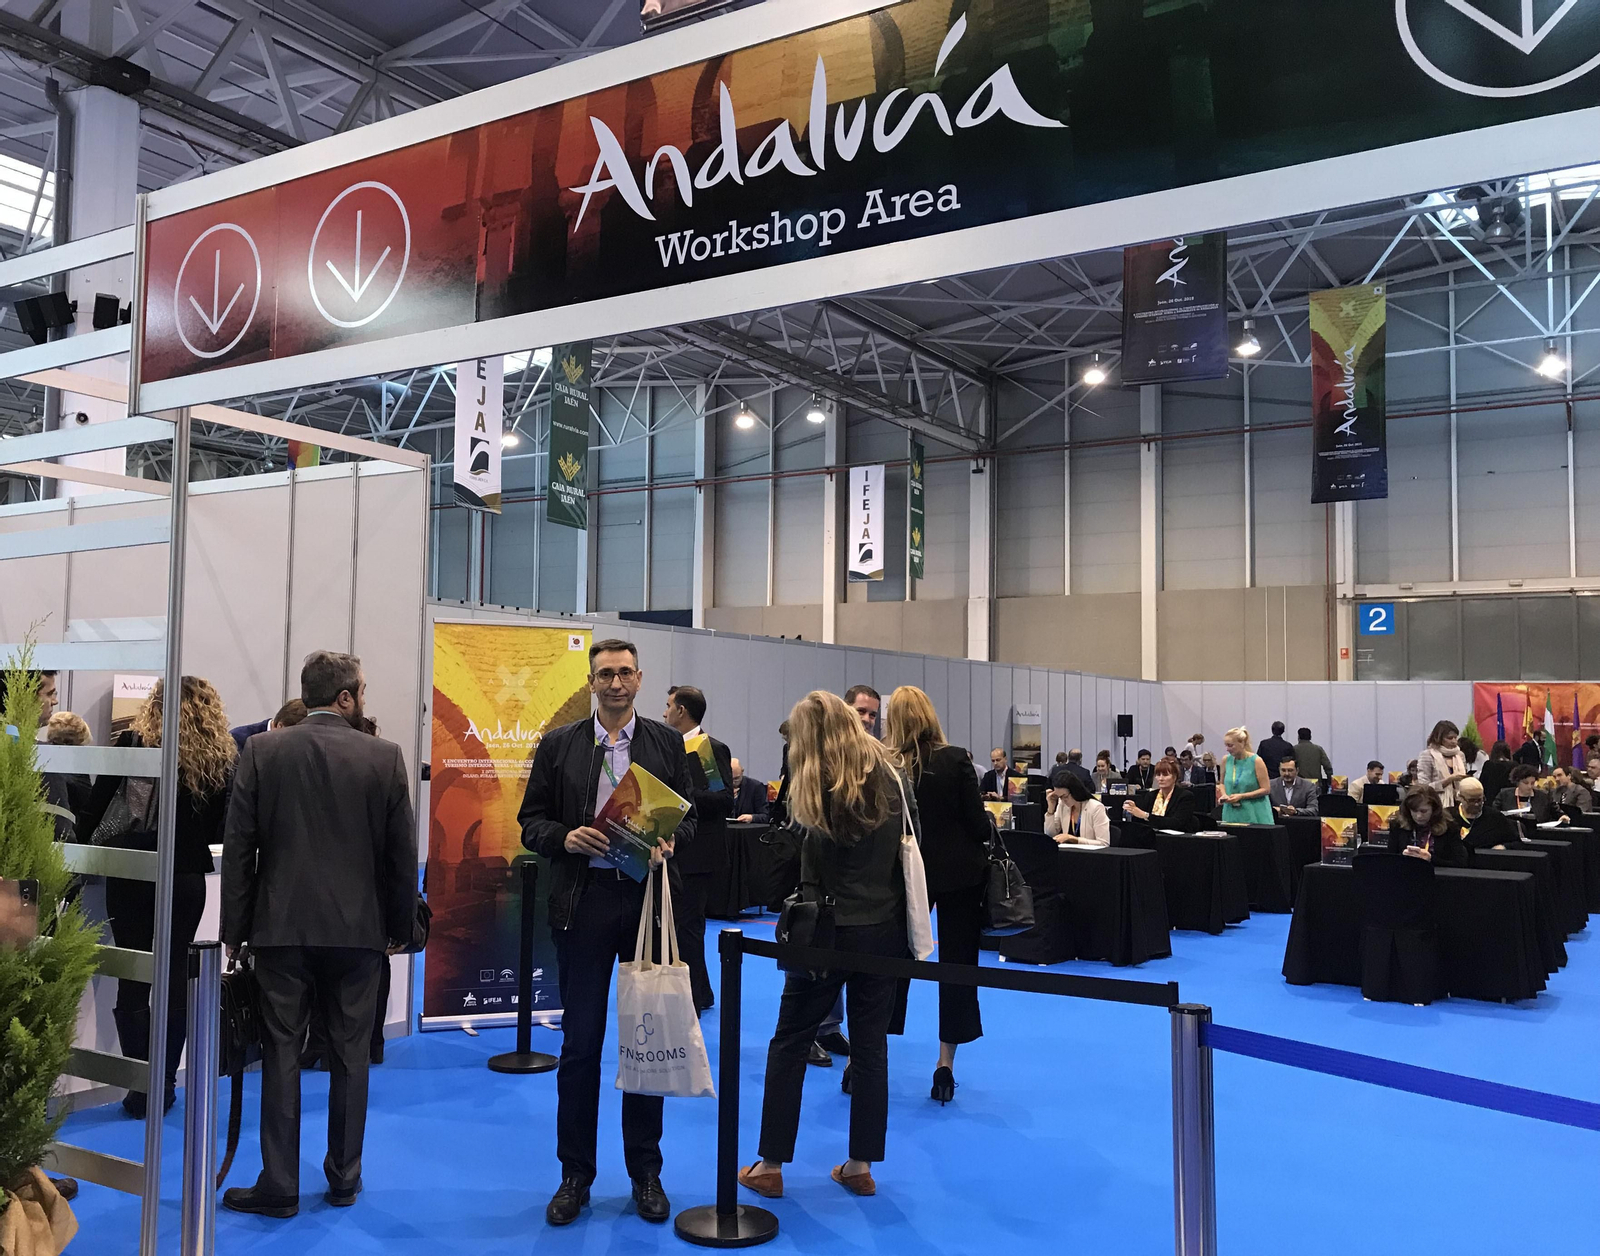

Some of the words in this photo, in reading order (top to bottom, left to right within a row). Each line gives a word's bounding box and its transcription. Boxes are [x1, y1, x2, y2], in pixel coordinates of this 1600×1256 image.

[568, 11, 1069, 233] Andalucía
[654, 206, 846, 268] Workshop
[857, 183, 961, 229] Area
[555, 382, 569, 394] CAJA
[569, 387, 589, 401] RURAL
[1333, 343, 1358, 437] Andalucía
[551, 481, 566, 493] CAJA
[566, 485, 586, 498] RURAL
[861, 470, 871, 540] IFEJA
[1368, 607, 1387, 631] 2
[463, 718, 545, 743] Andalucí
